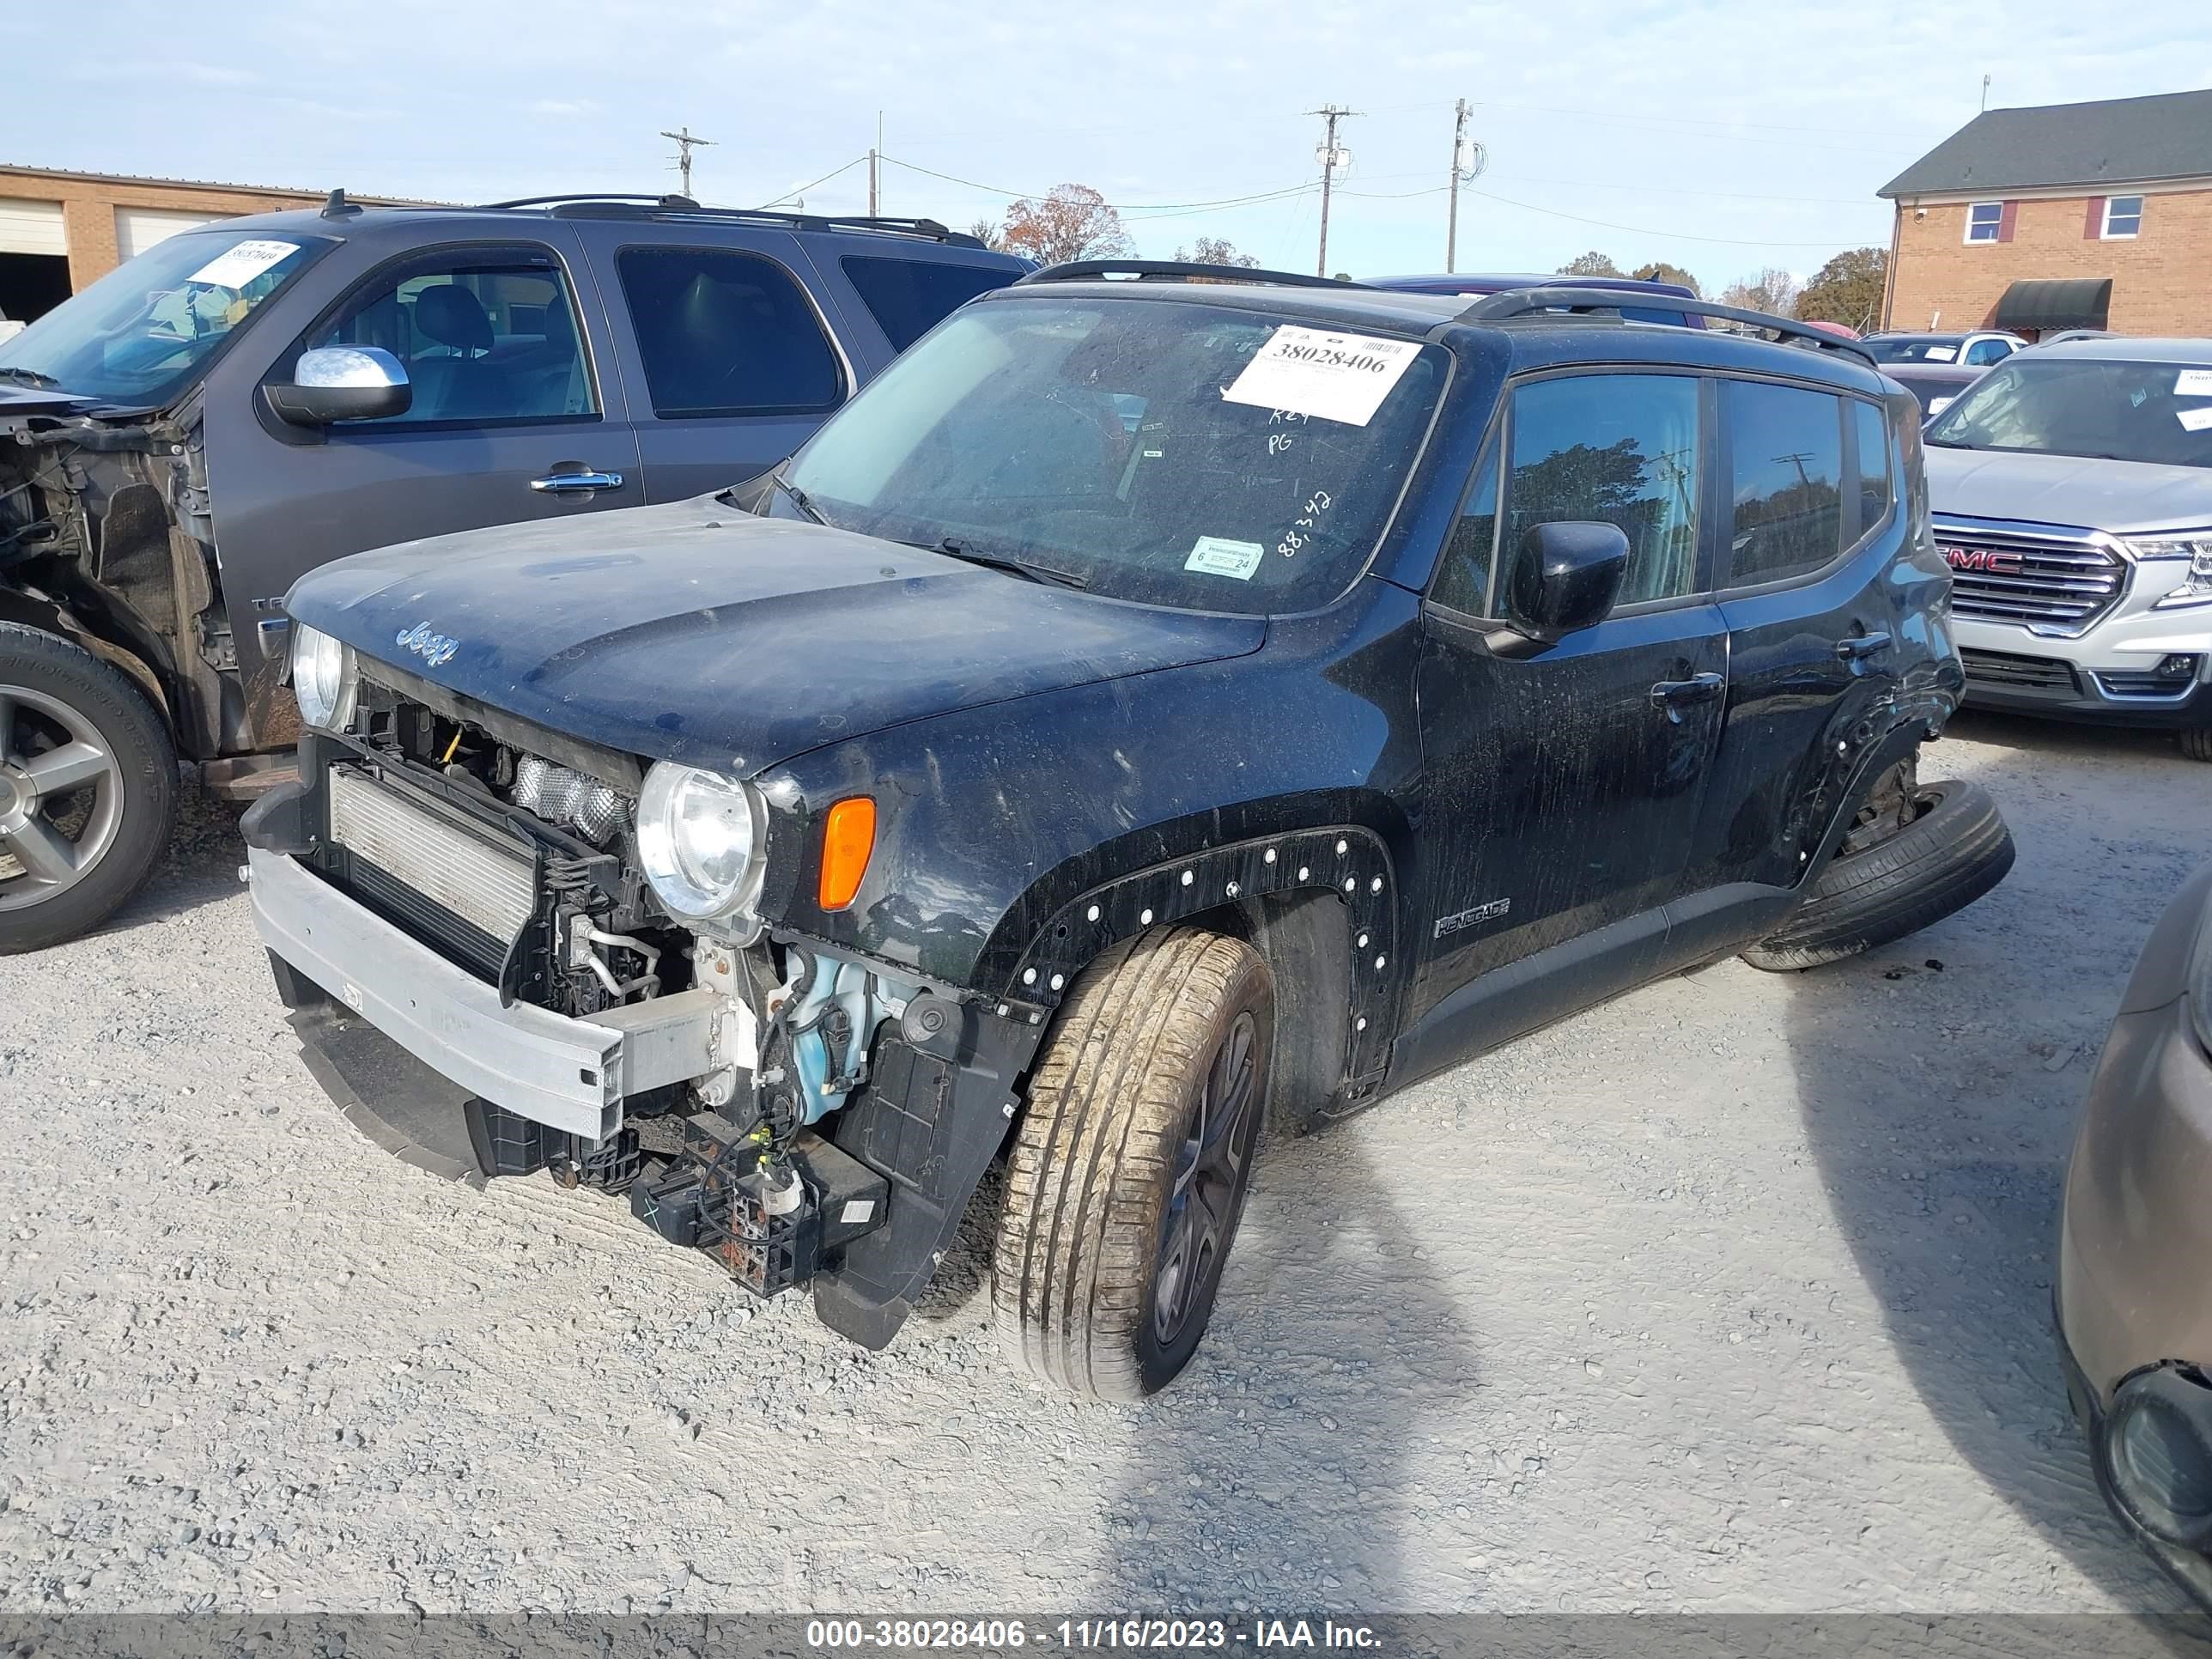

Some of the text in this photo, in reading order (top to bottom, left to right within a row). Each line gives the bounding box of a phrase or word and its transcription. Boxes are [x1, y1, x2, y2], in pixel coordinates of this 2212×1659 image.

[1273, 343, 1389, 374] 38028406
[1268, 434, 1292, 455] PG
[1278, 491, 1331, 557] 88,342
[1198, 552, 1205, 561] 6
[1236, 559, 1249, 569] 24
[396, 621, 459, 667] Jeep
[1434, 897, 1510, 940] RENEGADE
